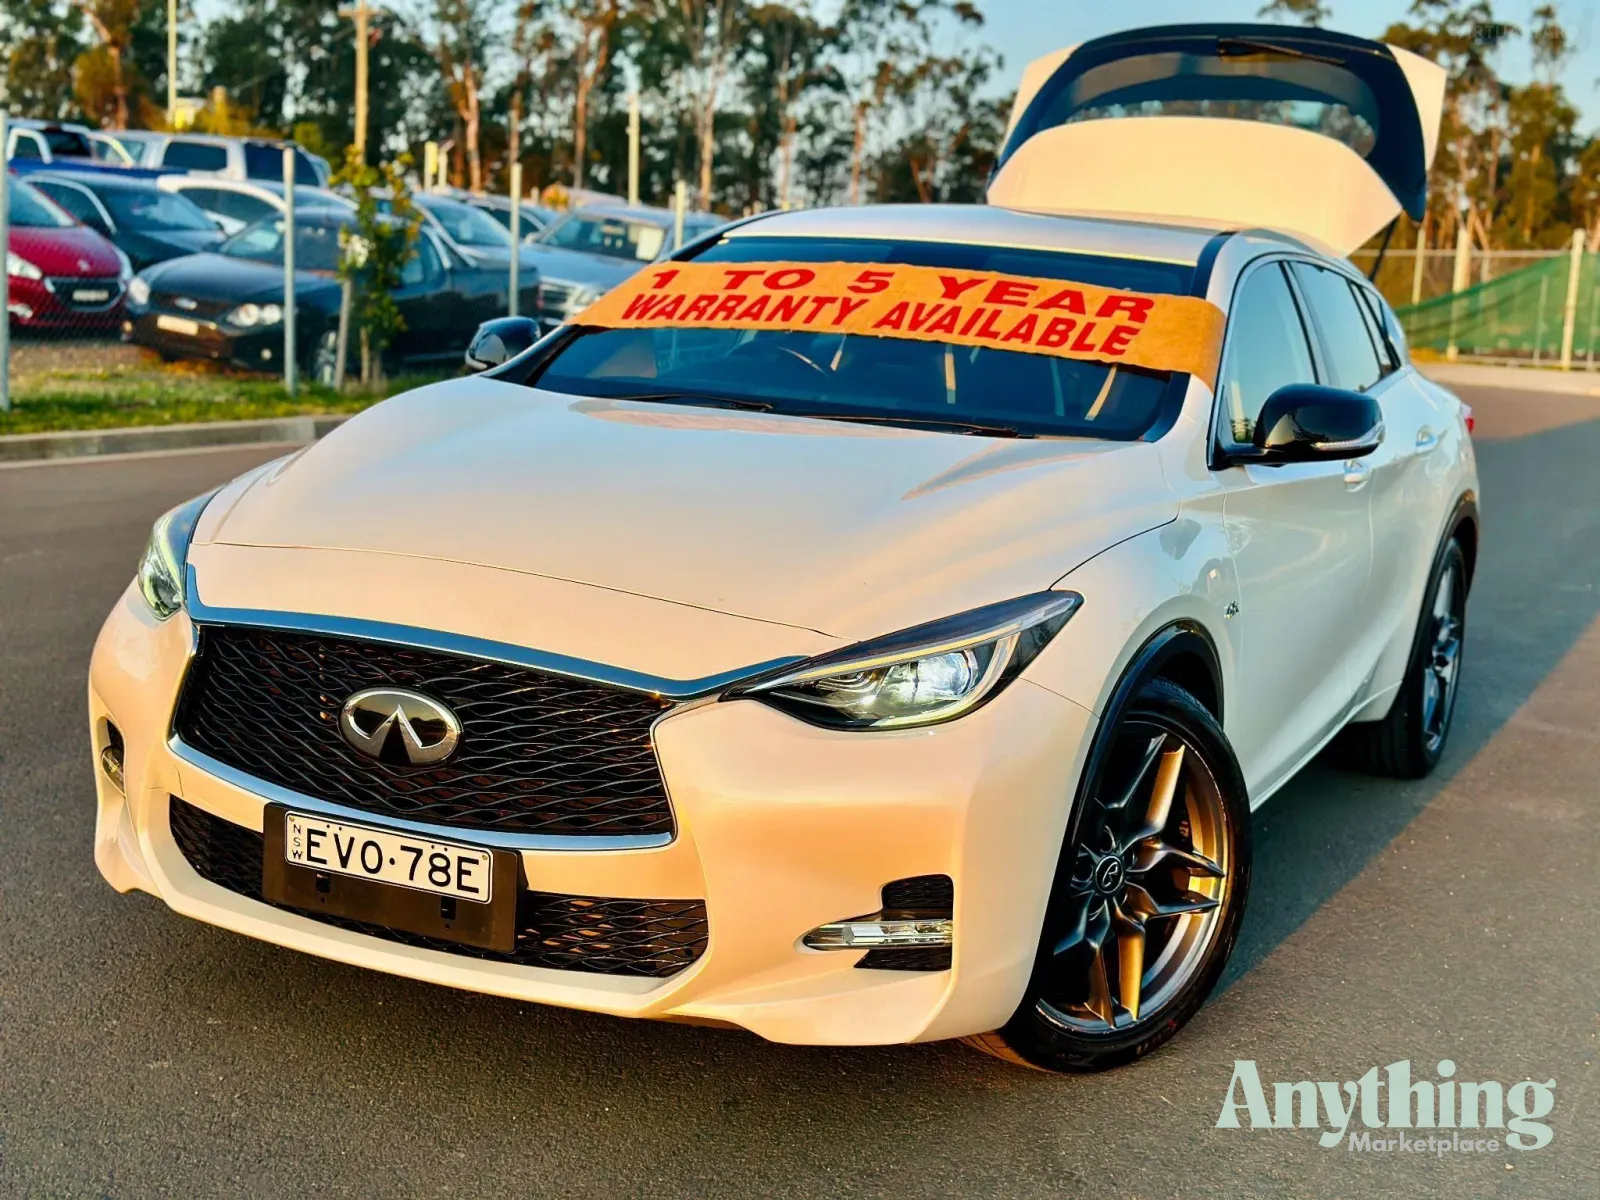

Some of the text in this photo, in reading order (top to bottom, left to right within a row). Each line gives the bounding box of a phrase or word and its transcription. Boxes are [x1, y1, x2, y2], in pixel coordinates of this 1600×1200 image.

[621, 294, 1140, 356] WARRANTY AVAILABLE
[652, 268, 1155, 324] 1 TO 5 YEAR
